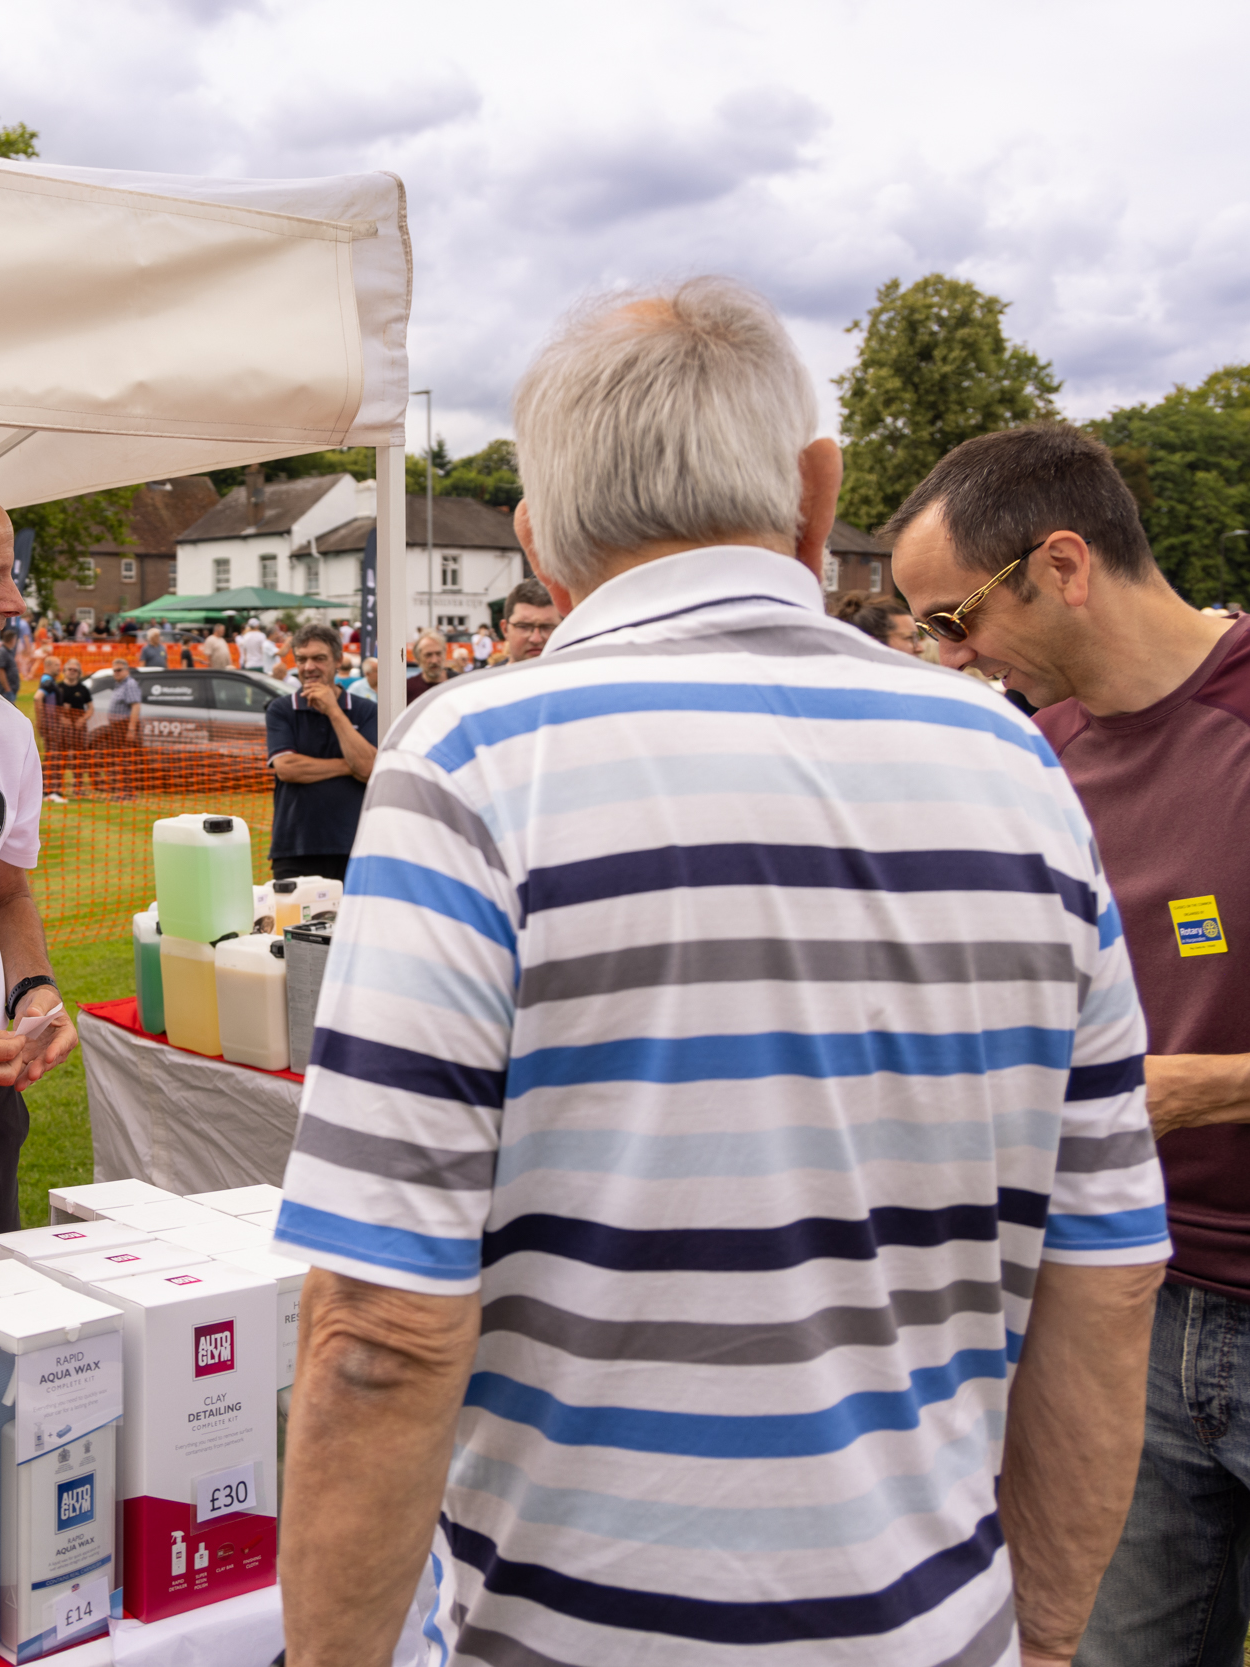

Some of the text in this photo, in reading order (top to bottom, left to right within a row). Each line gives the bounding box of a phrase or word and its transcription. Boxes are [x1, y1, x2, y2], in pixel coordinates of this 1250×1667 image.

[1180, 927, 1202, 936] Rotary
[198, 1331, 230, 1351] AUTO
[56, 1352, 84, 1367] RAPID
[198, 1346, 231, 1366] GLYM
[39, 1360, 100, 1385] AQUA WAX
[46, 1379, 81, 1393] COMPLETE
[204, 1393, 227, 1406] CLAY
[188, 1402, 242, 1422] DETAILING
[192, 1419, 225, 1431] COMPLETE
[62, 1485, 90, 1506] AUTO
[210, 1481, 248, 1512] £30
[61, 1498, 91, 1520] GLYM
[56, 1537, 95, 1556] AQUA WAX
[68, 1534, 84, 1544] RAPID
[66, 1601, 93, 1626] £14
